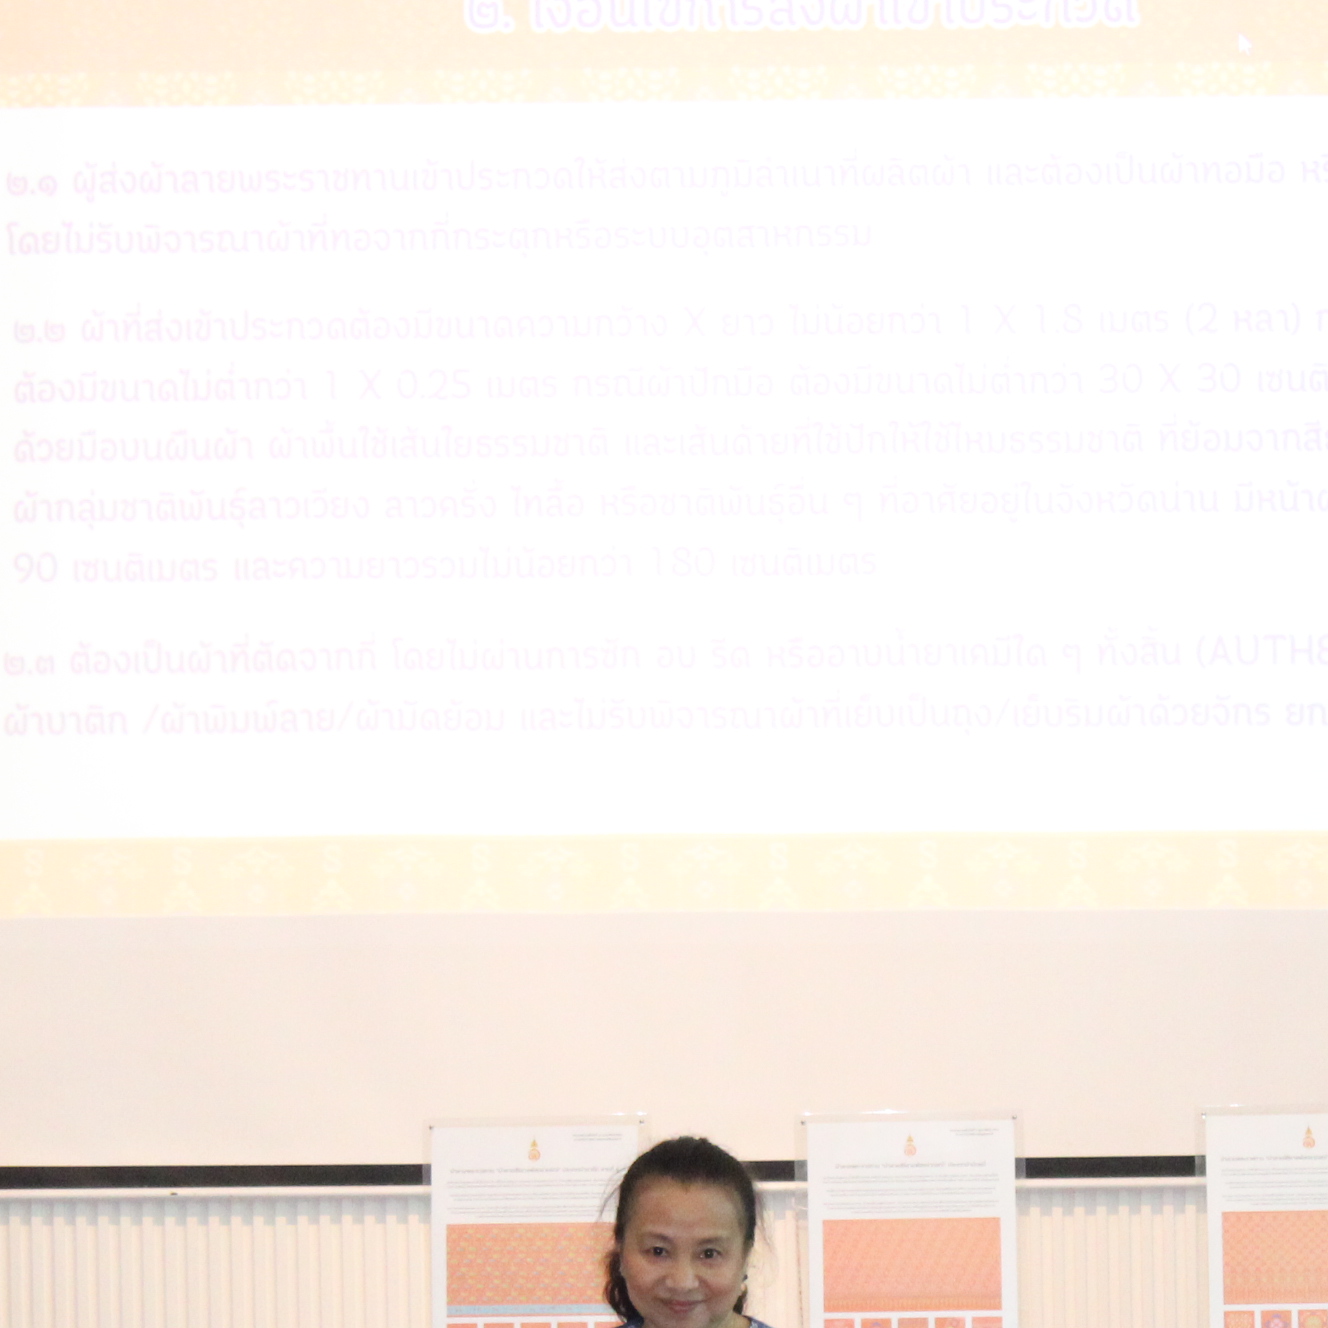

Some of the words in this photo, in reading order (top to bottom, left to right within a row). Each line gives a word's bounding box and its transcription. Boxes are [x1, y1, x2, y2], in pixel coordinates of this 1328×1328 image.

[721, 313, 774, 337] ยาว
[788, 303, 942, 336] ไม่น้อยกว่า
[1099, 309, 1169, 334] เมตร
[1185, 301, 1218, 335] (2
[1233, 302, 1301, 335] หลา)
[13, 368, 308, 405] ต้องมีขนาดไม่ต่ำกว่า
[326, 369, 336, 400] 1
[359, 369, 382, 400] X
[396, 368, 472, 401] 0.25
[486, 374, 558, 399] เมตร
[572, 365, 774, 398] กรณีผ้าปักมือ
[789, 362, 1084, 396] ต้องมีขนาดไม่ต่ำกว่า
[1099, 362, 1143, 395] 30
[1159, 363, 1181, 393] X
[1198, 362, 1242, 394] 30
[12, 427, 254, 464] ด้วยมือบนผืนผ้า
[268, 420, 609, 460] ผ้าพื้นใช้เส้นใยธรรมชาติ
[12, 487, 371, 531] ผ้ากลุ่มชาติพันธุ์ลาวเวียง
[384, 487, 497, 519] ลาวครั่ง
[510, 478, 585, 518] ไทลื้อ
[600, 483, 829, 524] หรือชาติพันธุ์อื่น
[12, 551, 59, 584] 90
[72, 552, 218, 584] เซนติเมตร
[233, 546, 633, 582] และความยาวรวมไม่น้อยกว่า
[652, 545, 716, 578] 180
[732, 546, 877, 578] เซนติเมตร
[69, 638, 377, 676] ต้องเป็นผ้าที่ตัดจากกี่
[391, 636, 641, 672] โดยไม่ผ่านการซัก
[656, 645, 697, 670] อบ
[710, 637, 751, 669] รีด
[766, 627, 1048, 669] หรืออาบน้ำยาเคมีใด
[1097, 625, 1182, 667] ทั้งสิ้น
[2, 702, 129, 737] ผ้าบาติก
